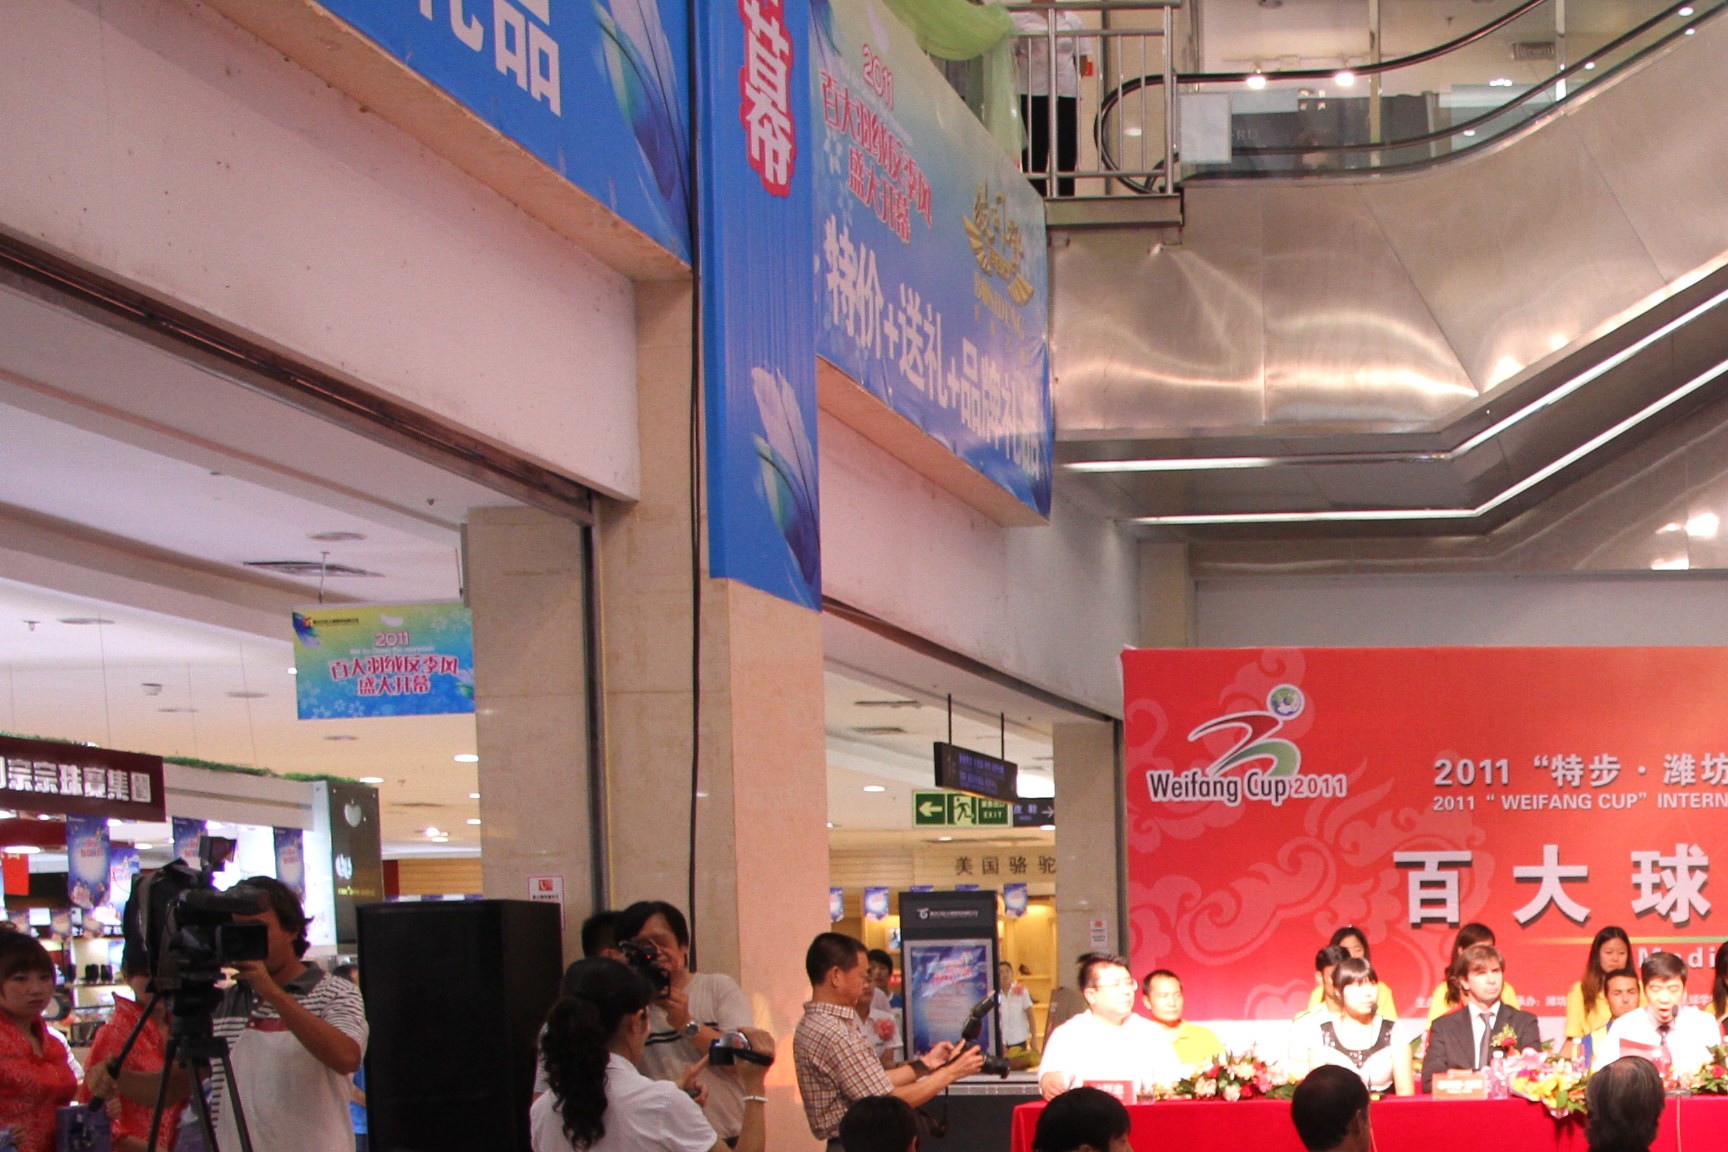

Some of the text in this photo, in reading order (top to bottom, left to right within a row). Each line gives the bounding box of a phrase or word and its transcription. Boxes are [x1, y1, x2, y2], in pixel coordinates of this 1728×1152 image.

[375, 631, 410, 647] 2011
[1434, 758, 1510, 786] 2011
[1148, 770, 1346, 804] Weifang Cup 2011
[1433, 796, 1475, 811] 2011
